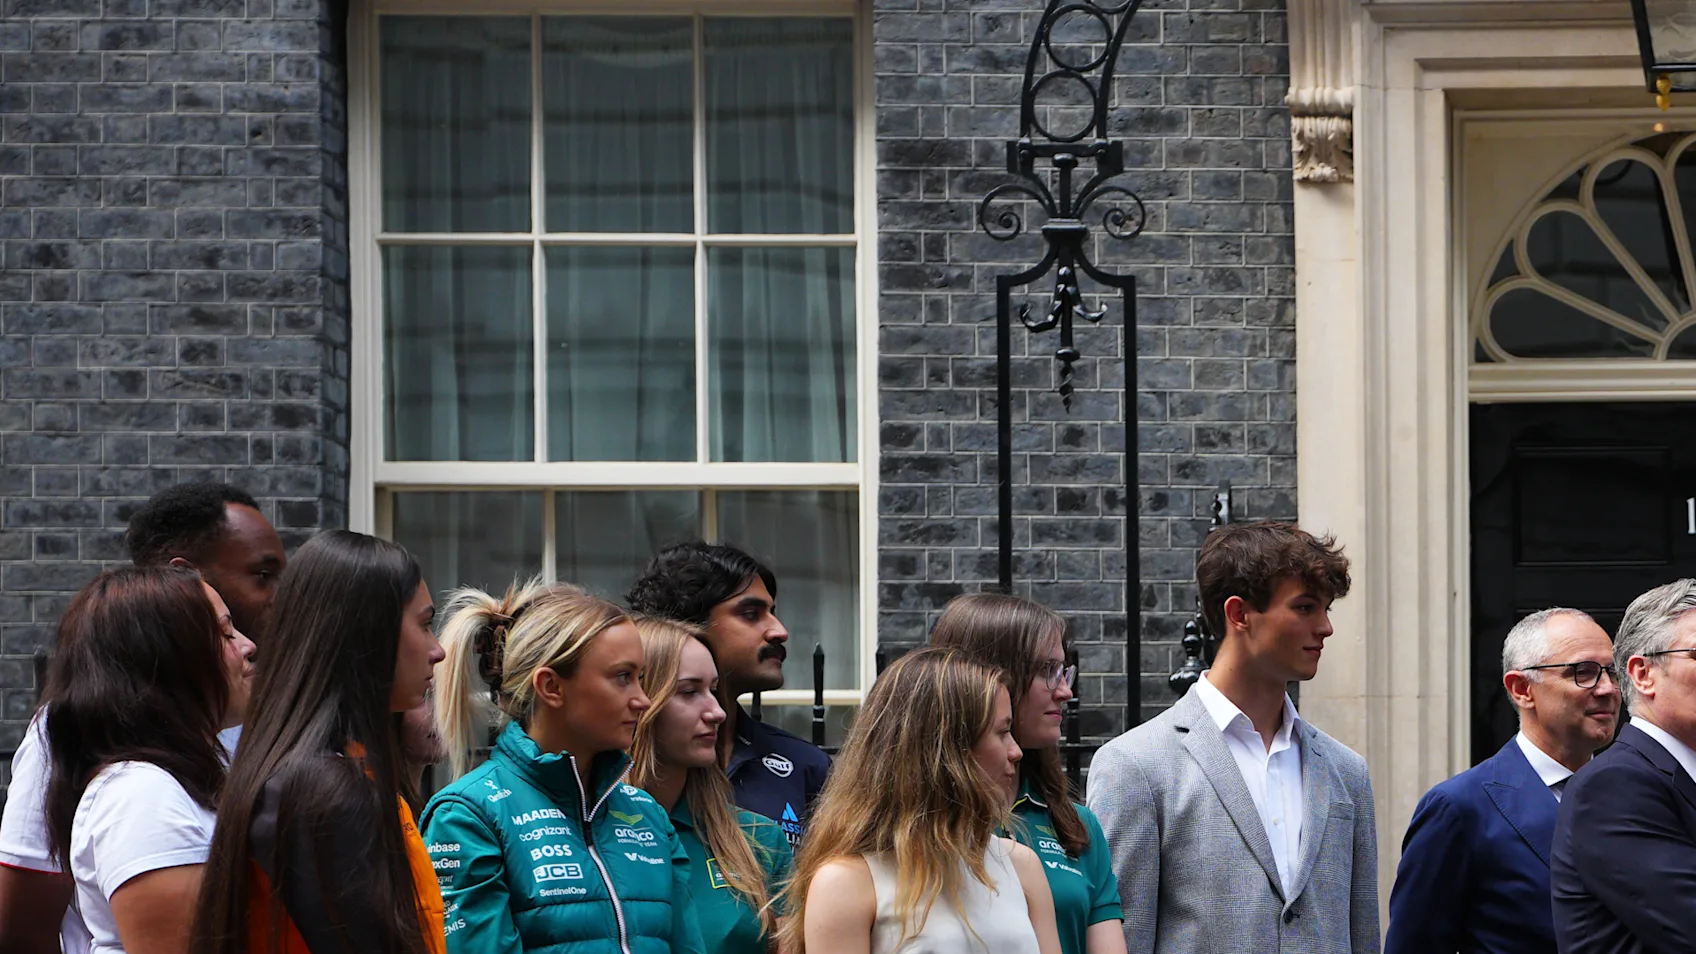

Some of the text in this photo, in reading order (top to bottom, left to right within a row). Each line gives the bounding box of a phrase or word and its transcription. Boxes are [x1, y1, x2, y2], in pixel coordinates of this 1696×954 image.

[511, 809, 567, 825] MAADEN
[519, 826, 572, 842] cognizant
[428, 842, 460, 853] inbase
[530, 844, 573, 861] BOSS
[432, 858, 460, 869] xGen
[536, 864, 582, 881] JCB
[540, 887, 587, 897] SentinelOne
